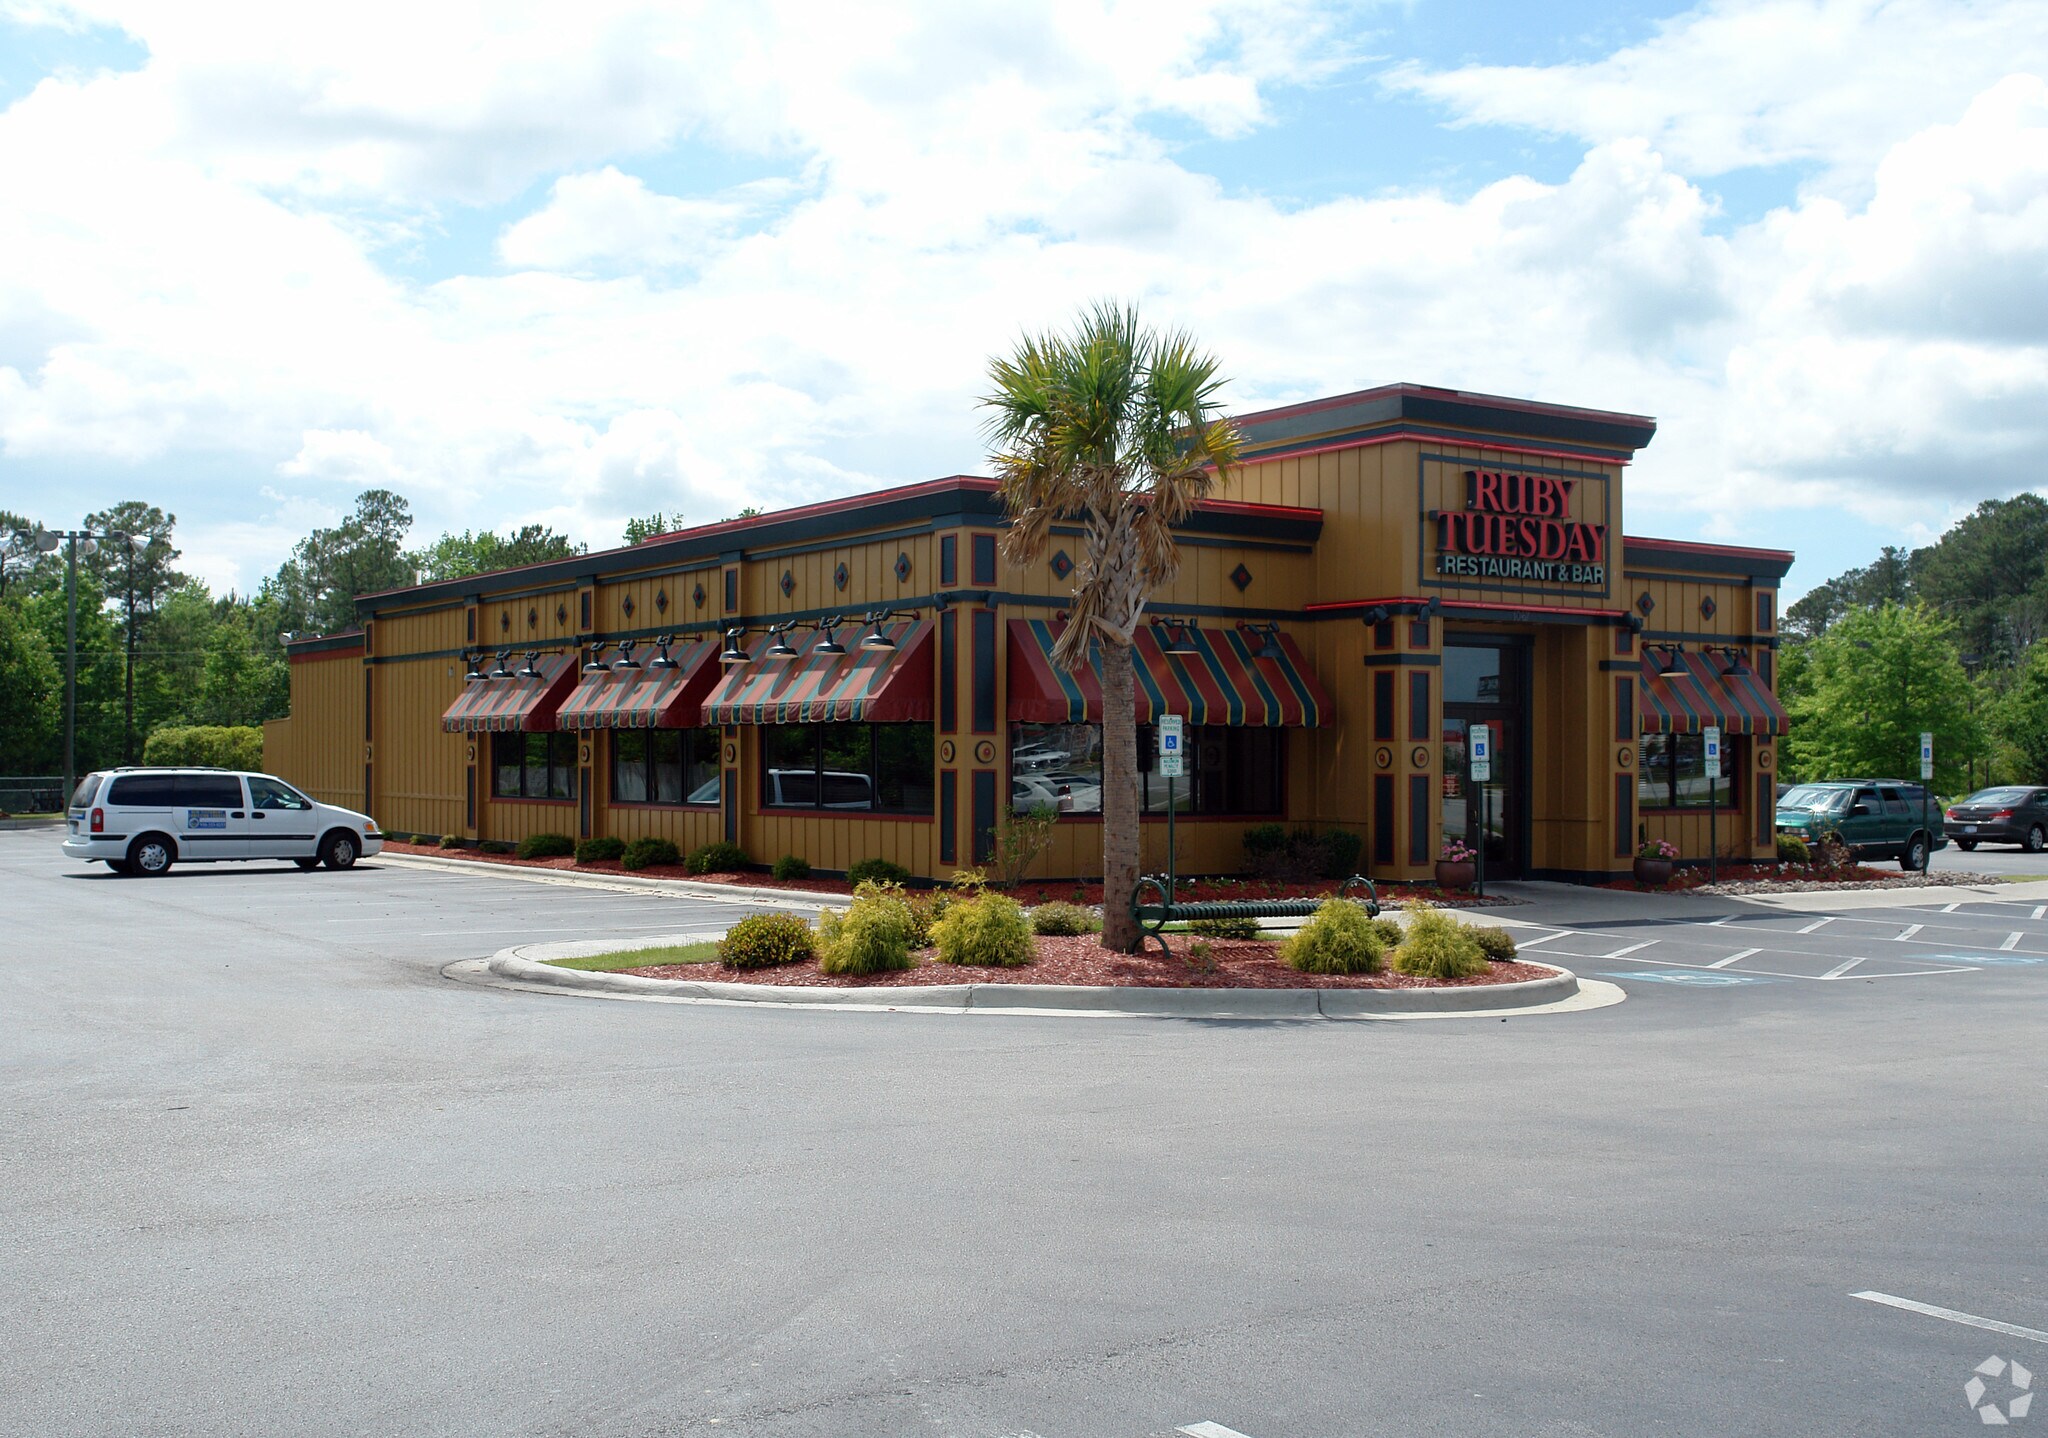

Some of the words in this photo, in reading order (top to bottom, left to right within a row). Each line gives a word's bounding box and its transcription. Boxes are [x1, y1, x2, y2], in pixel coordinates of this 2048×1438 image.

[1473, 470, 1578, 518] RUBY
[1437, 511, 1609, 562] TUESDAY
[1445, 556, 1555, 581] RESTAURANT
[1558, 564, 1570, 582] &
[1572, 566, 1605, 584] BAR
